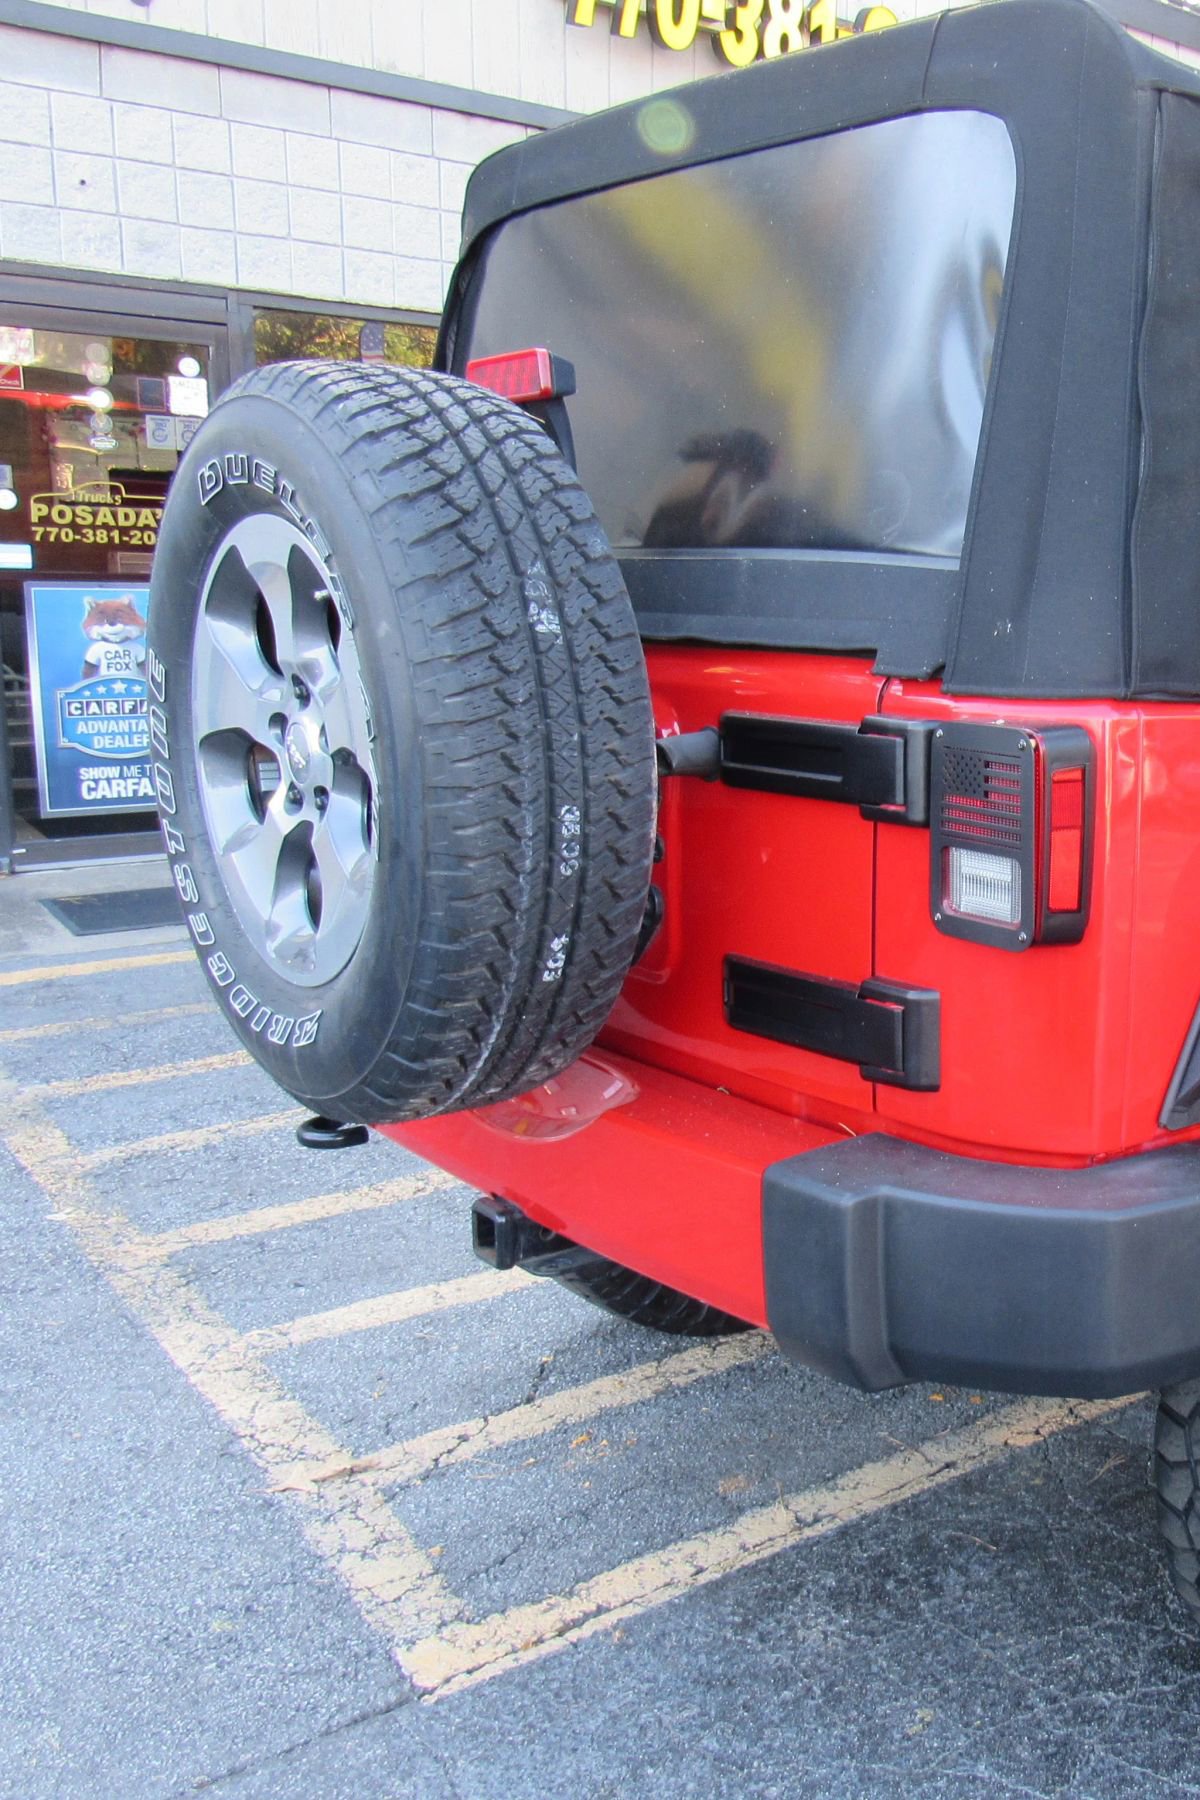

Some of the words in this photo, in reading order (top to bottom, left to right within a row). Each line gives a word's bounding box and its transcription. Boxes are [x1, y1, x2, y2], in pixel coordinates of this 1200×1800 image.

[76, 489, 122, 506] Trucks
[32, 503, 163, 527] POSADA'
[33, 528, 156, 544] 770-381-20
[104, 651, 132, 660] CAR
[107, 661, 132, 671] FOX
[69, 701, 148, 715] CARF
[76, 718, 149, 735] ADVANTA
[80, 767, 120, 779] SHOW
[124, 766, 142, 777] ME
[81, 778, 156, 800] CARFA
[149, 648, 324, 1047] BRIDGESTONE
